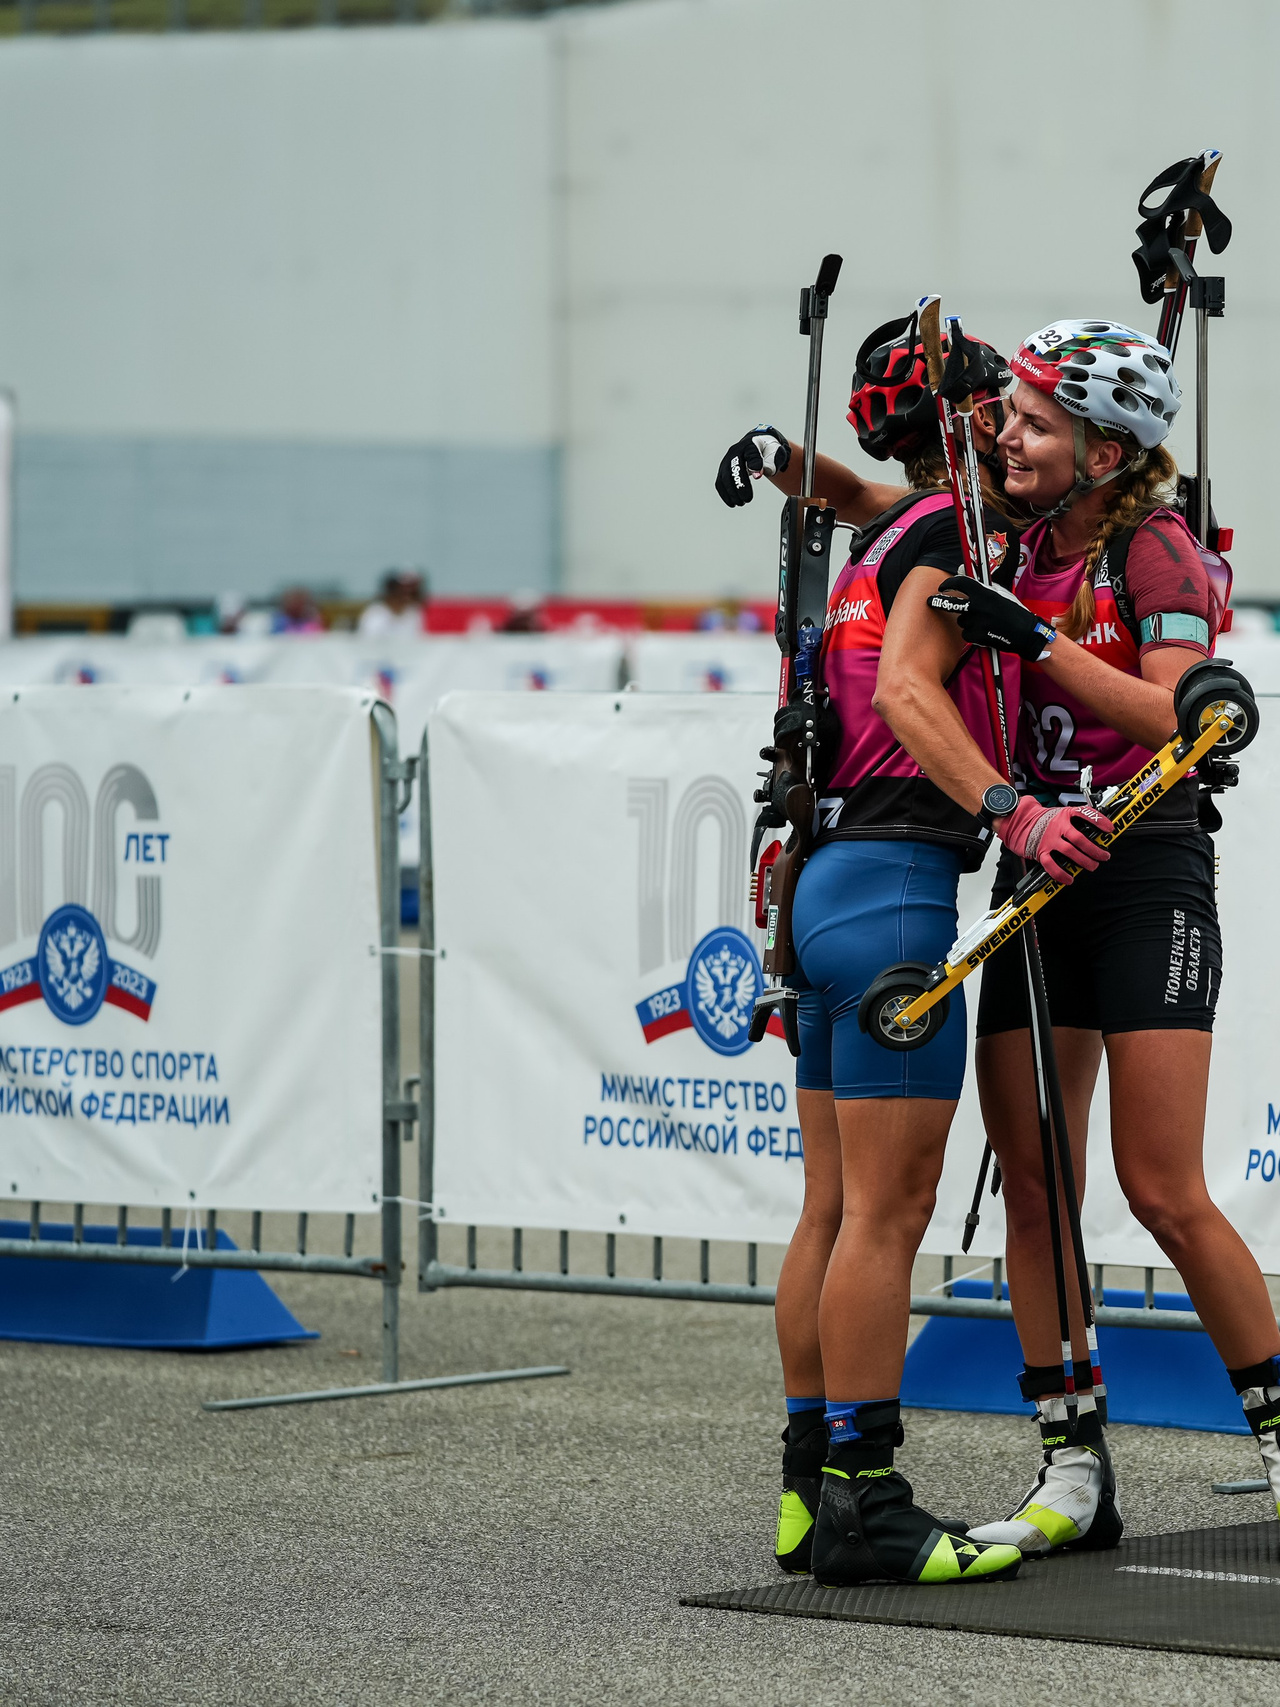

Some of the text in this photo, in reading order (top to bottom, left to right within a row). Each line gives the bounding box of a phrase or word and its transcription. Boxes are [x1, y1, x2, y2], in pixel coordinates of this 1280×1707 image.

[1037, 329, 1063, 348] 32
[1052, 391, 1090, 413] catlike
[1100, 782, 1165, 845] SWENOR
[124, 833, 170, 863] ЛЕТ
[966, 905, 1033, 969] SWENOR
[1164, 908, 1186, 1005] ТЮМЕНСКАЯ
[1186, 926, 1201, 992] ОБЛАСТЬ
[1, 962, 33, 992] 1923
[111, 963, 148, 999] 2023
[647, 987, 682, 1019] 1923
[131, 1050, 219, 1083] СПОРТА
[80, 1089, 231, 1129] ФЕДЕРАЦИИ
[600, 1071, 786, 1114] МИНИСТЕРСТВО
[584, 1112, 738, 1156] РОССИЙСКОЙ
[834, 1419, 844, 1427] 26
